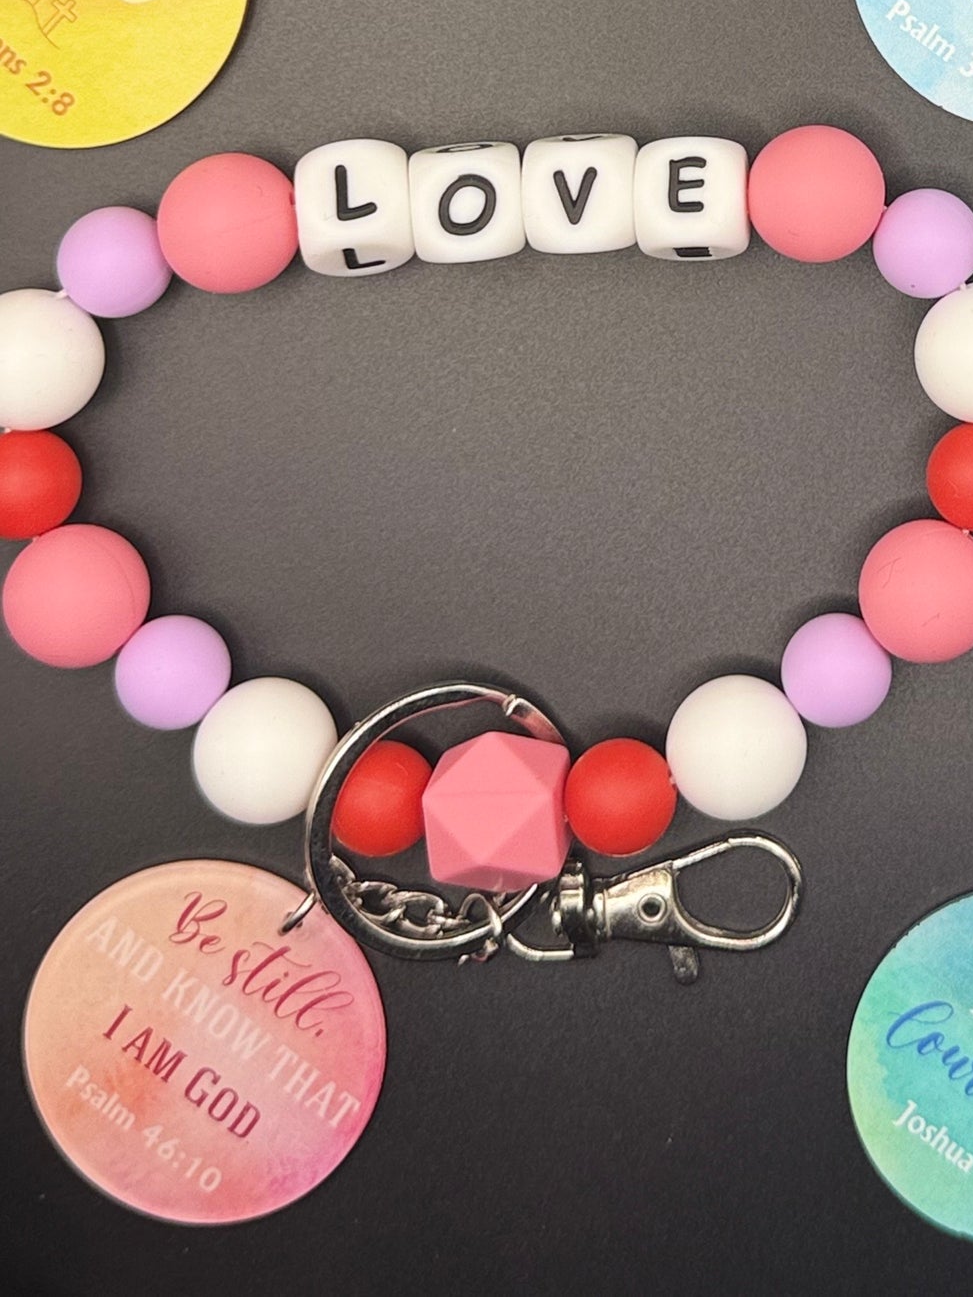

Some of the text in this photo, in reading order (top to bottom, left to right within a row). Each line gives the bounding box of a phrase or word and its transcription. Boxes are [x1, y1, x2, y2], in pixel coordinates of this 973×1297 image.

[25, 70, 75, 116] 2:8
[334, 156, 708, 236] LOVE
[169, 891, 228, 954] Be
[86, 916, 362, 1129] AND KNOW THAT
[102, 1004, 261, 1138] I AM GOD
[66, 1064, 223, 1192] Psalm 46:10
